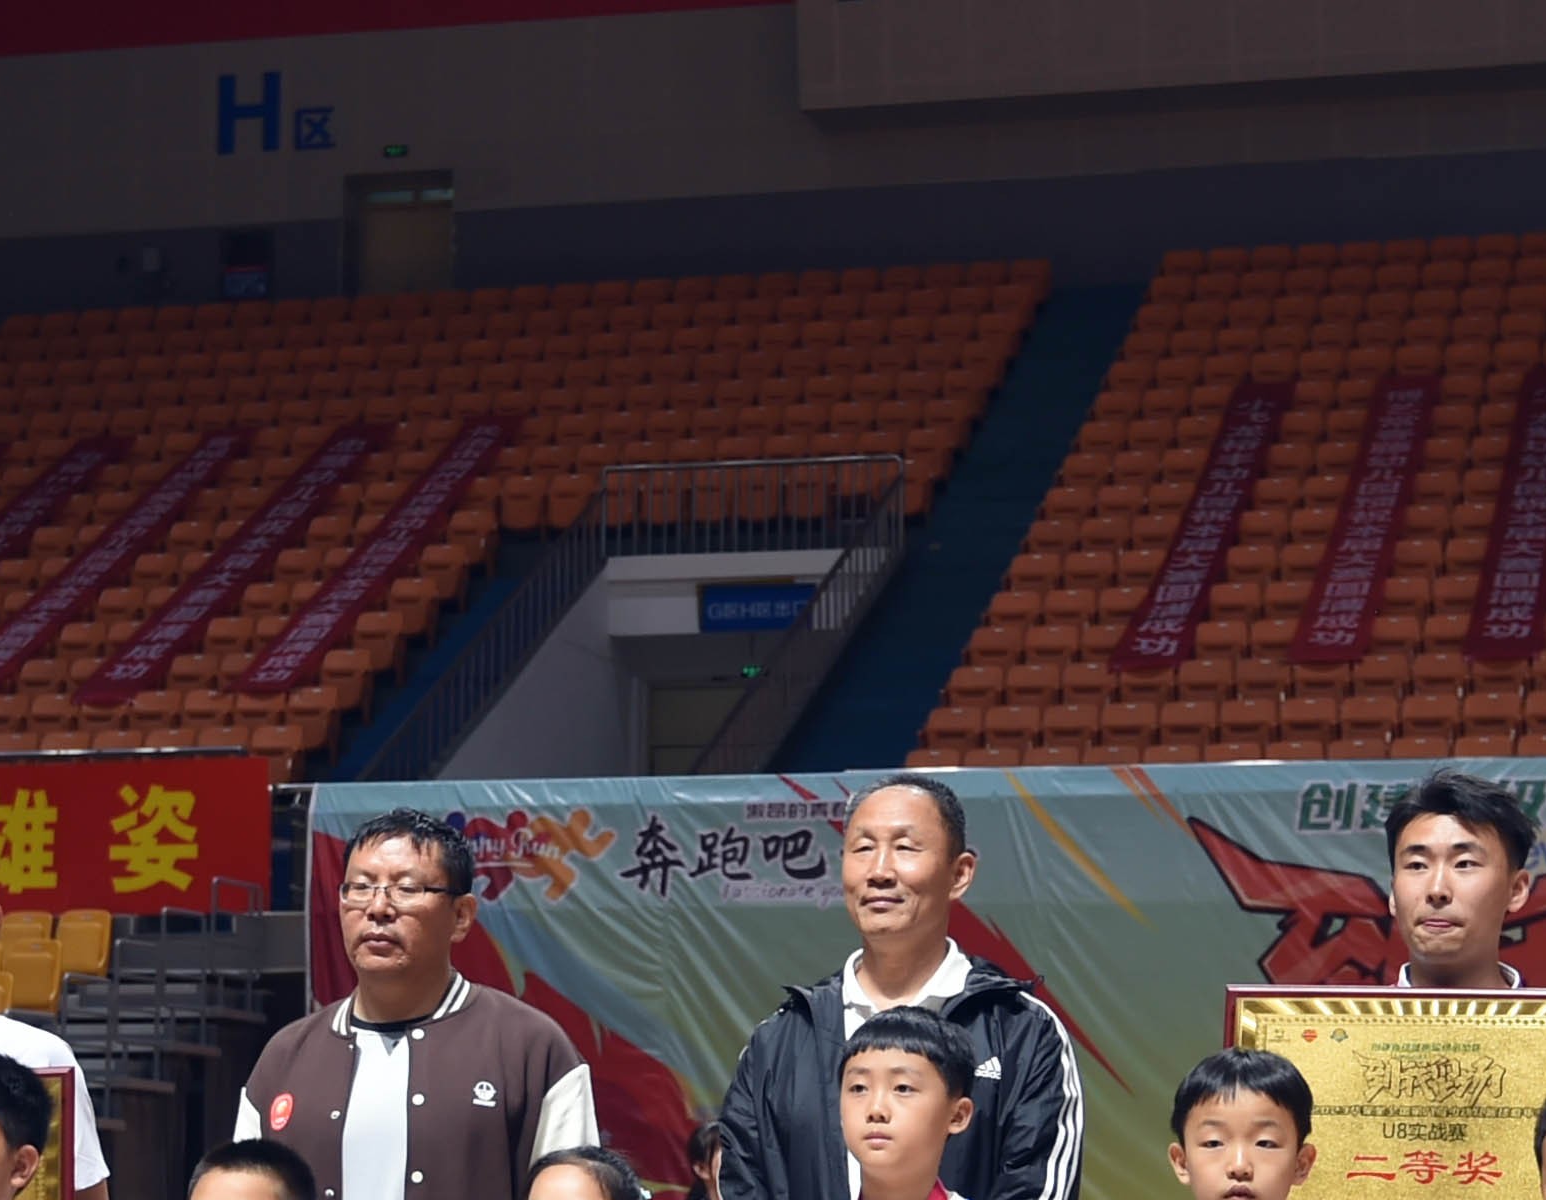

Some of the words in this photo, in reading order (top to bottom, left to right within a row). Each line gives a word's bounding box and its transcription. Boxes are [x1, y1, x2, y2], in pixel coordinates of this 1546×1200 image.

[216, 71, 336, 155] H区
[1382, 1122, 1468, 1142] U8实战赛
[1346, 1150, 1503, 1186] 二等奖
